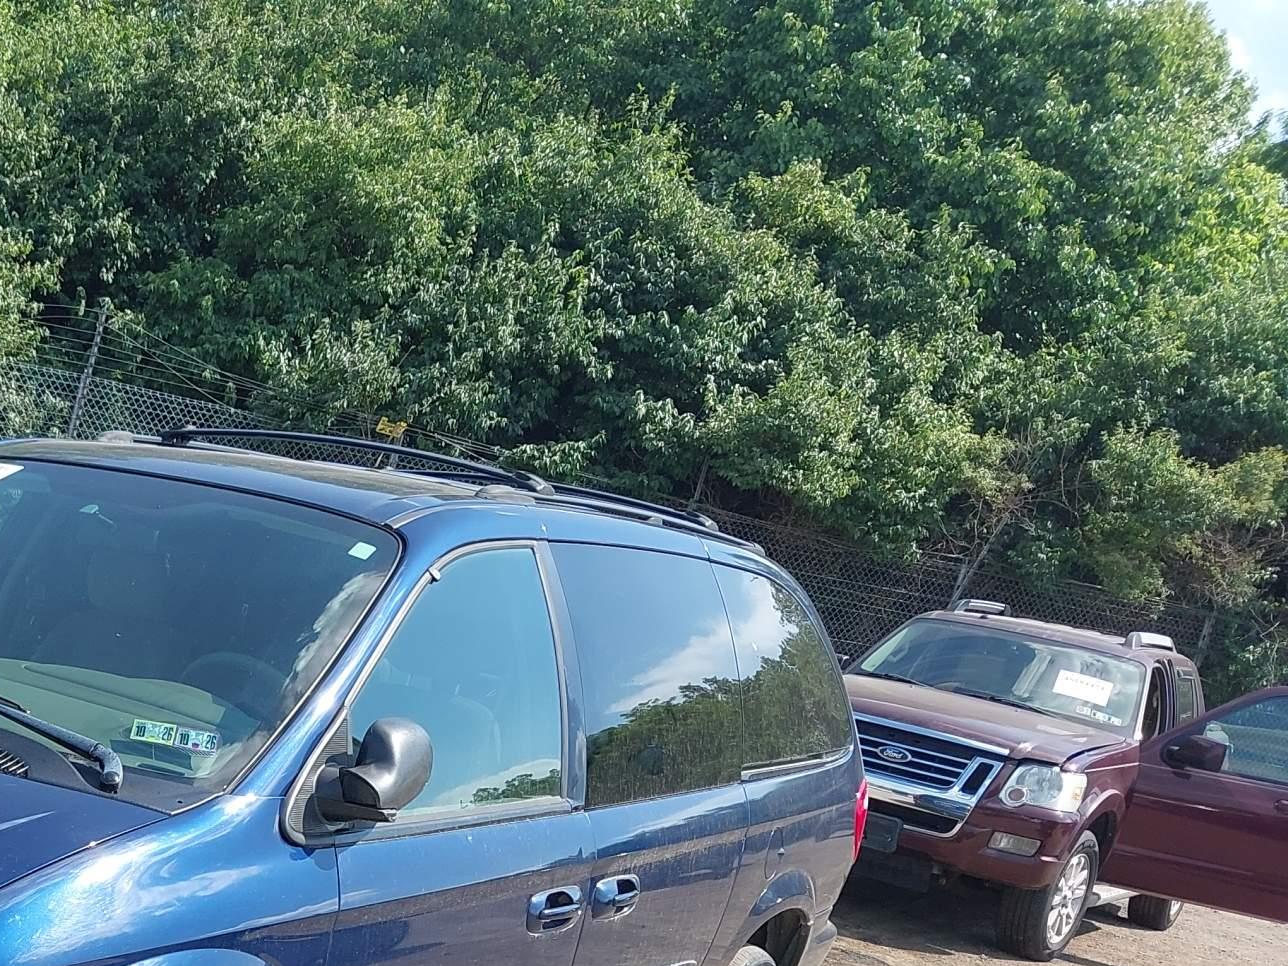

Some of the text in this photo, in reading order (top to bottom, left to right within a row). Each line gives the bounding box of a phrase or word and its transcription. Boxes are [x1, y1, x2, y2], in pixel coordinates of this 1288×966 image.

[135, 725, 146, 737] 10
[161, 726, 174, 741] 26
[179, 733, 217, 750] 10 26
